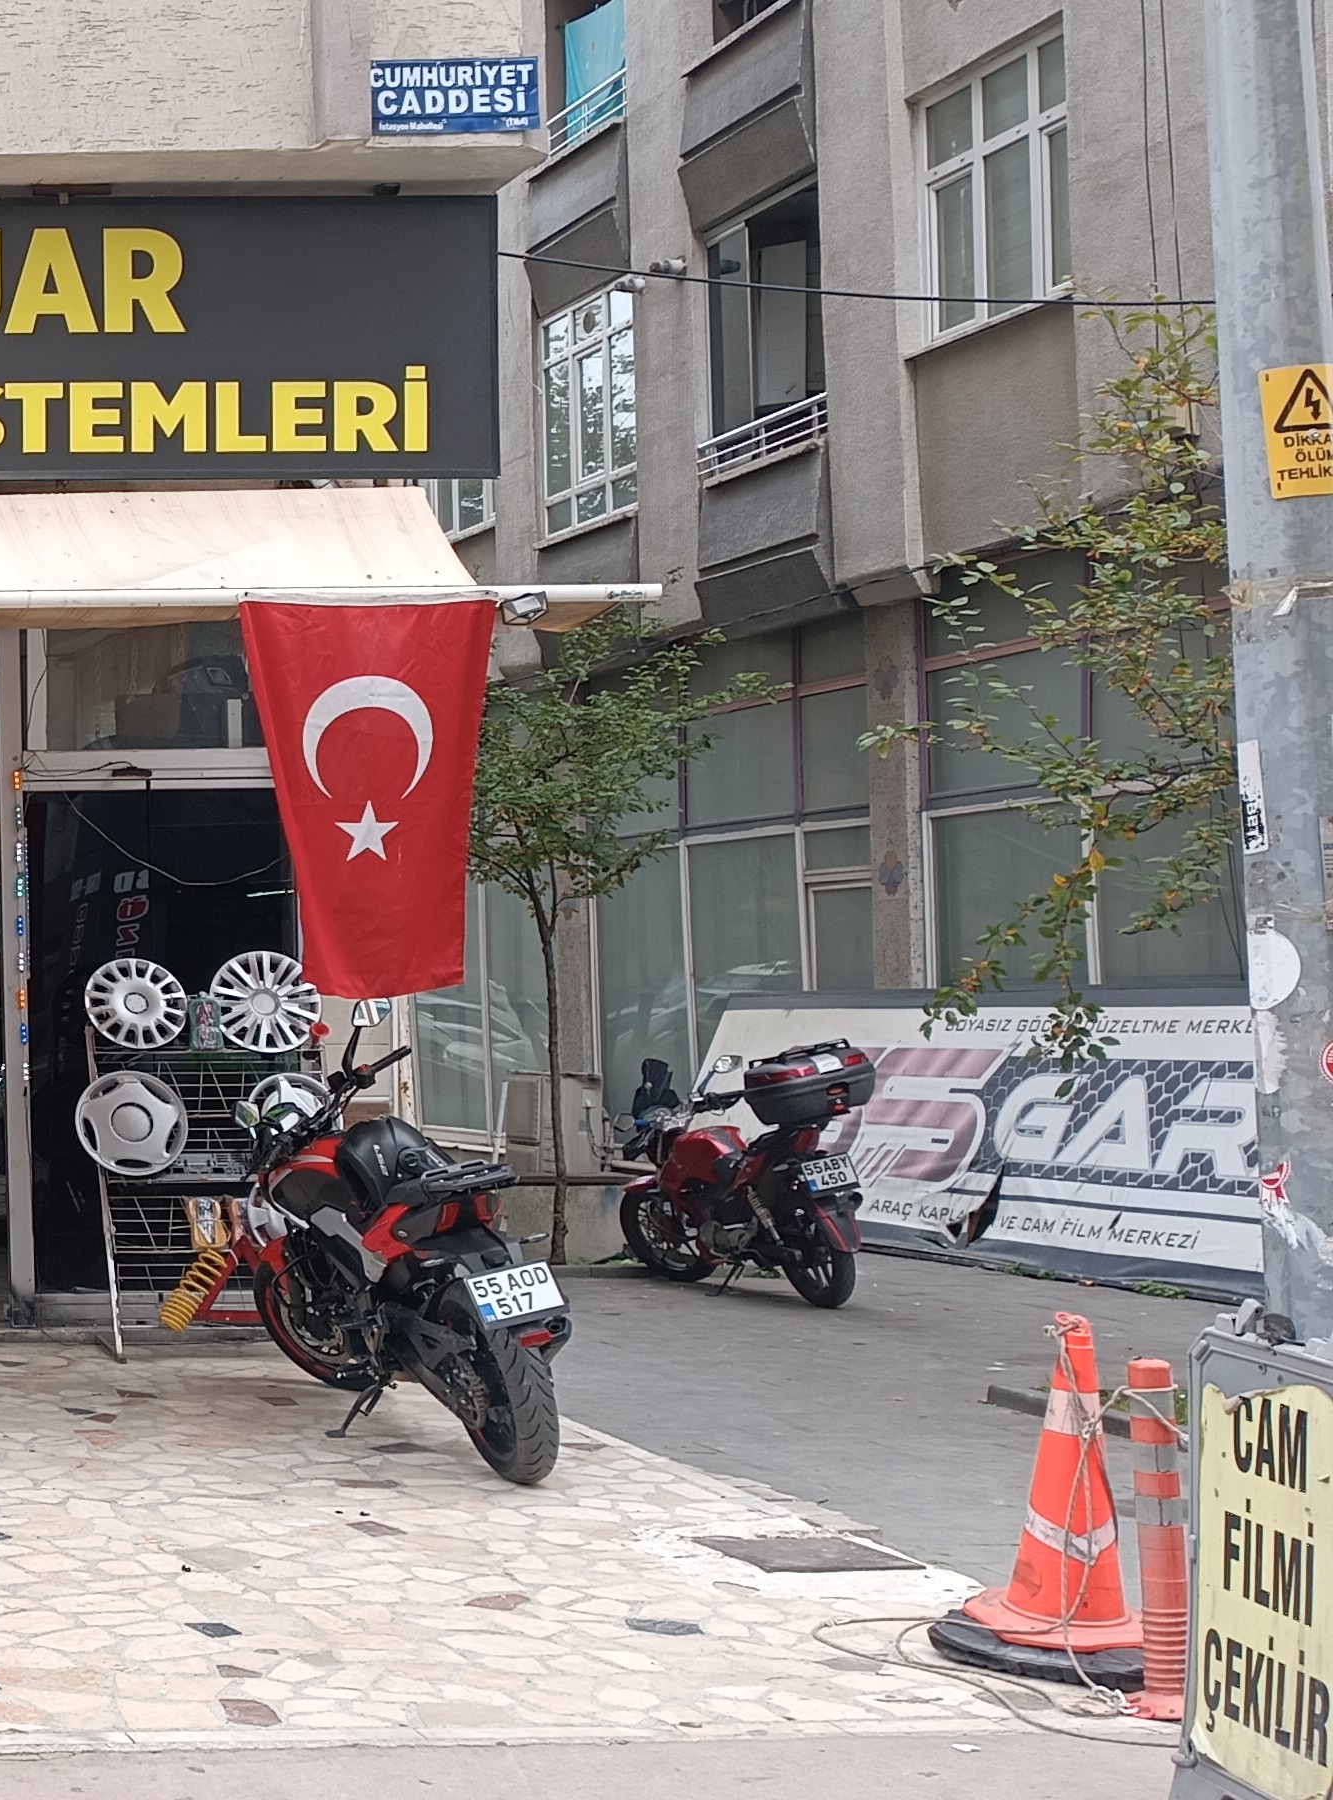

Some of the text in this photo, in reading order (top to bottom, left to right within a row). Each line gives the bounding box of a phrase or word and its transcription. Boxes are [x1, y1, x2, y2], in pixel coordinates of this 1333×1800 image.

[370, 62, 533, 87] CUMHURİYET
[377, 87, 526, 115] CADDESİ
[821, 1172, 847, 1186] 450
[869, 1199, 914, 1221] ARAÇ
[1001, 1215, 1017, 1230] VE
[1022, 1216, 1056, 1234] CAM
[1060, 1217, 1102, 1239] FİLM
[1109, 1228, 1201, 1250] MERKEZİ
[473, 1266, 548, 1298] 55 AOD
[496, 1292, 533, 1316] 517
[1233, 1397, 1308, 1493] CAM
[1223, 1498, 1314, 1626] FİLMİ
[1203, 1628, 1329, 1768] ÇEKİLİR
